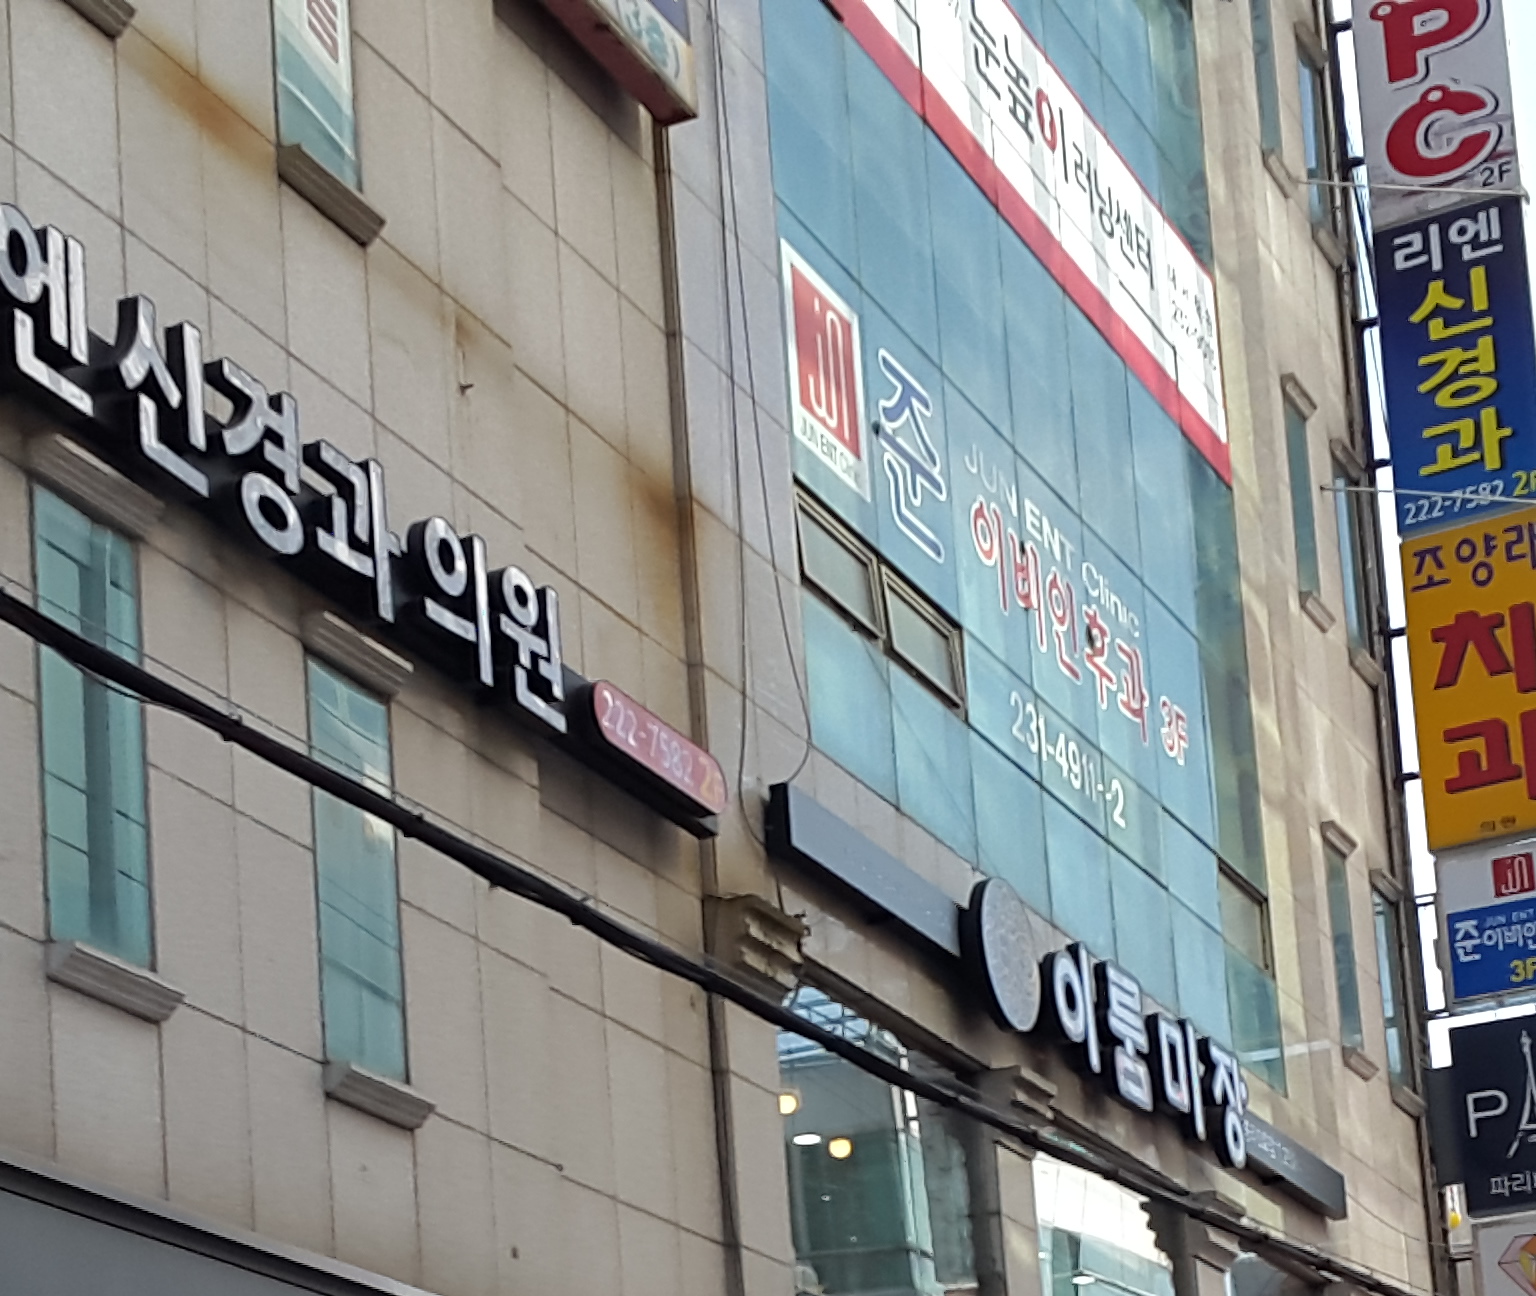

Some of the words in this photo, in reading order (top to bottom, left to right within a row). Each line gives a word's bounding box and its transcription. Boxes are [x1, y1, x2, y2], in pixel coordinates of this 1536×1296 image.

[1392, 206, 1504, 272] 리엔
[1479, 163, 1513, 188] 2F
[1408, 265, 1514, 477] 신경과
[964, 443, 1019, 517] JUN
[1023, 498, 1076, 572] ENT
[1081, 560, 1140, 638] Clinic
[416, 514, 568, 736] 의원
[970, 495, 1150, 747] 이비인후과
[1159, 695, 1190, 766] 3F
[601, 688, 695, 787] 222-7582
[1453, 919, 1482, 963] 준
